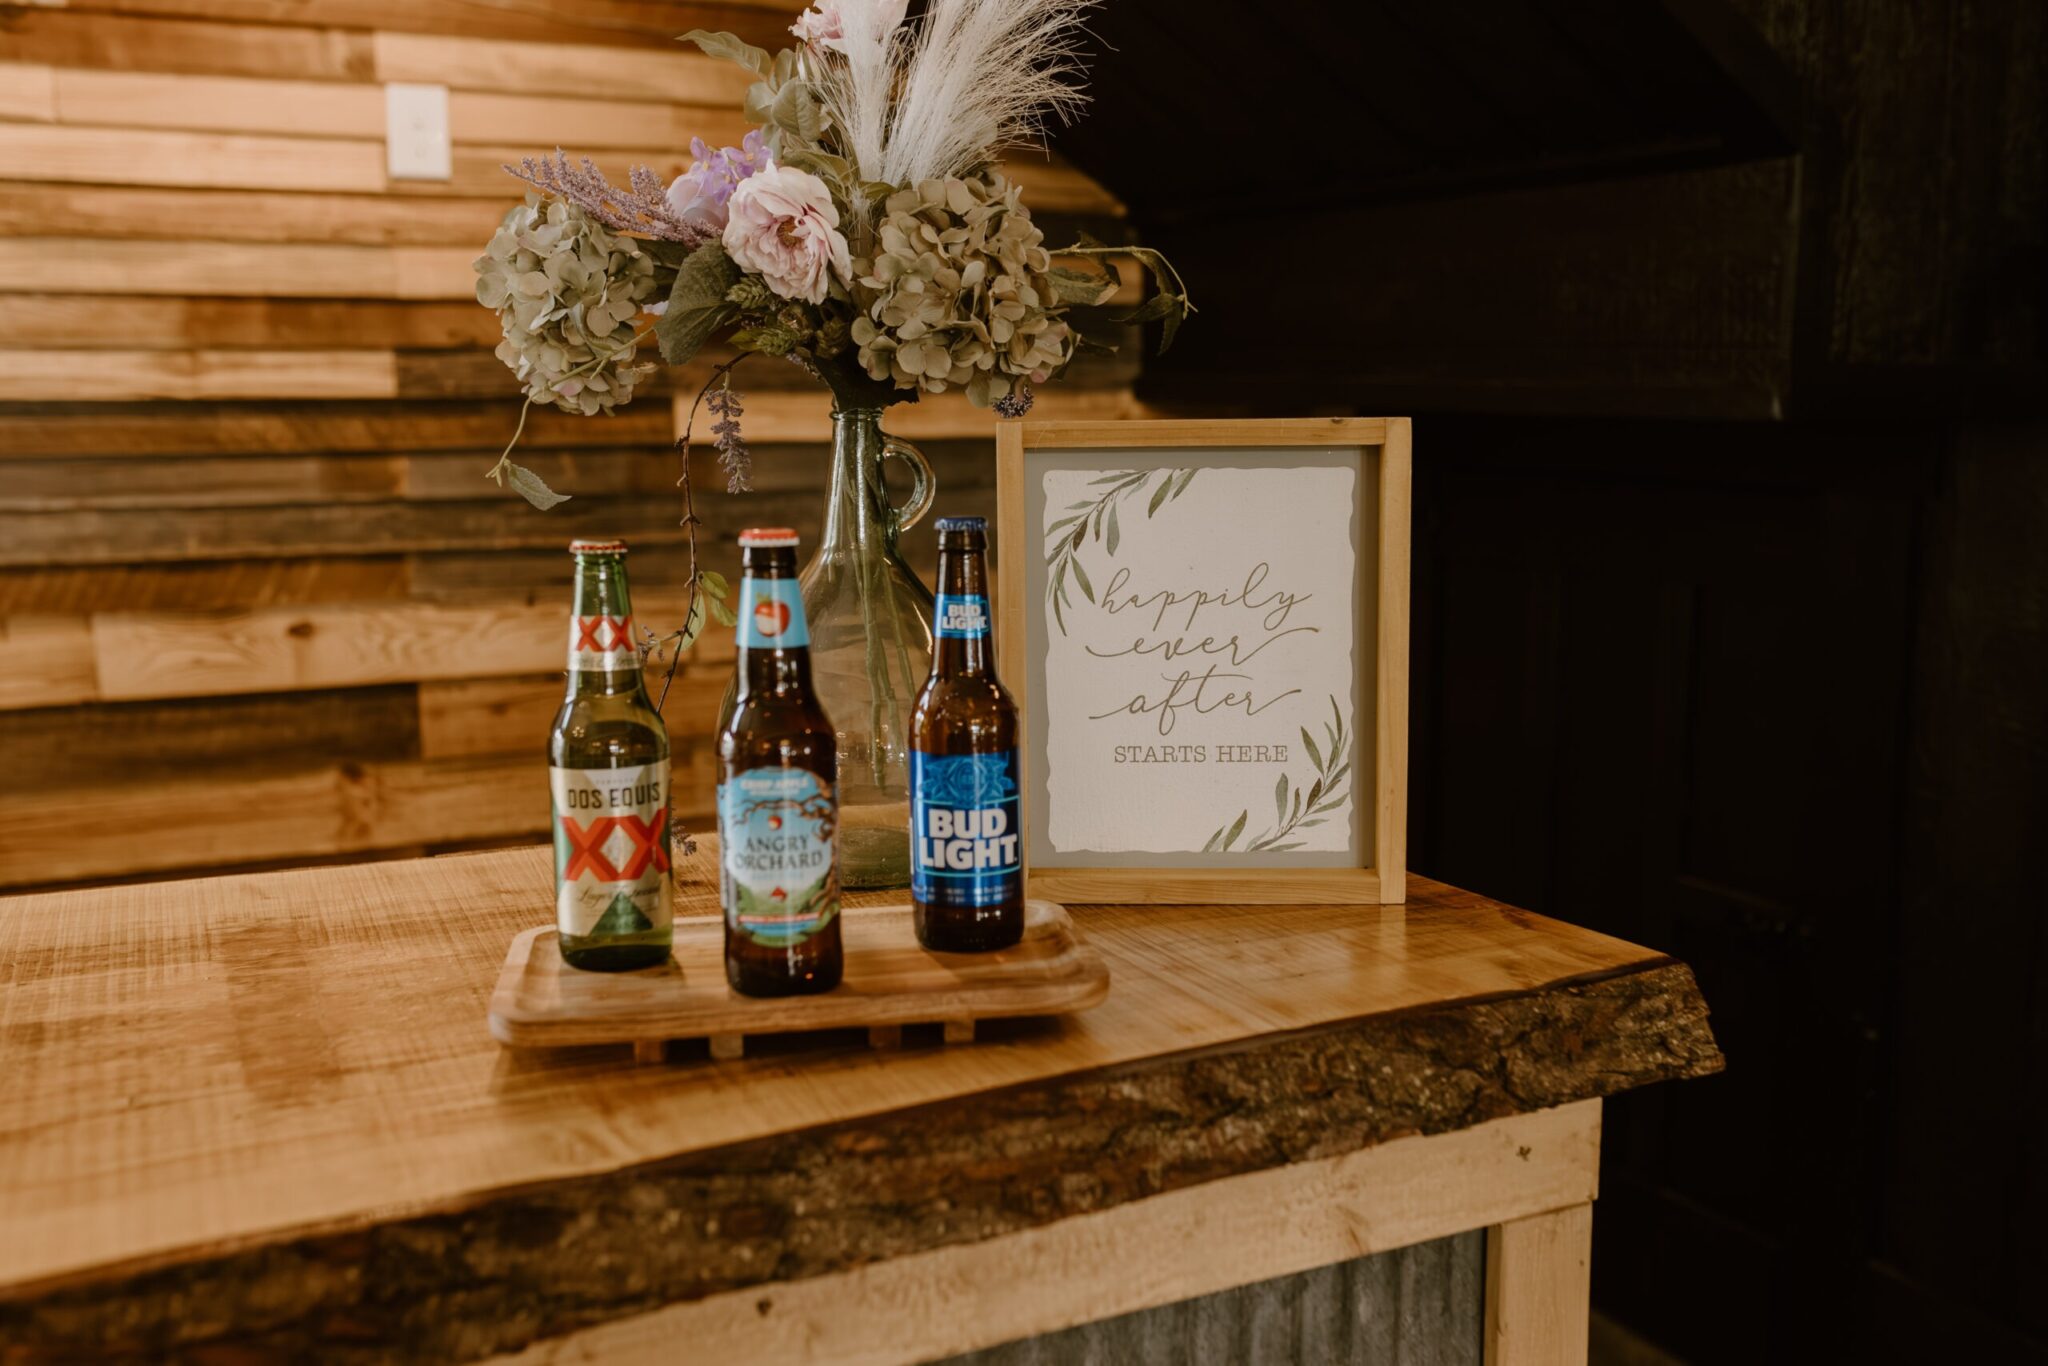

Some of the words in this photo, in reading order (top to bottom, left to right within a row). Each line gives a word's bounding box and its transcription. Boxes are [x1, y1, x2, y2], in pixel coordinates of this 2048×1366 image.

[947, 604, 982, 617] BUD
[1102, 562, 1313, 631] happily
[576, 615, 636, 652] XX
[942, 616, 988, 630] LIGHT
[1085, 626, 1320, 666] ever
[1088, 663, 1303, 736] after
[1113, 745, 1207, 763] STARTS
[1215, 745, 1289, 763] HERE
[567, 788, 603, 809] DOS
[609, 781, 661, 808] EQUIS
[927, 808, 1008, 840] BUD
[561, 807, 669, 882] XX
[745, 836, 809, 852] ANGRY
[919, 833, 1018, 871] LIGHT
[735, 851, 823, 871] ORCHARD
